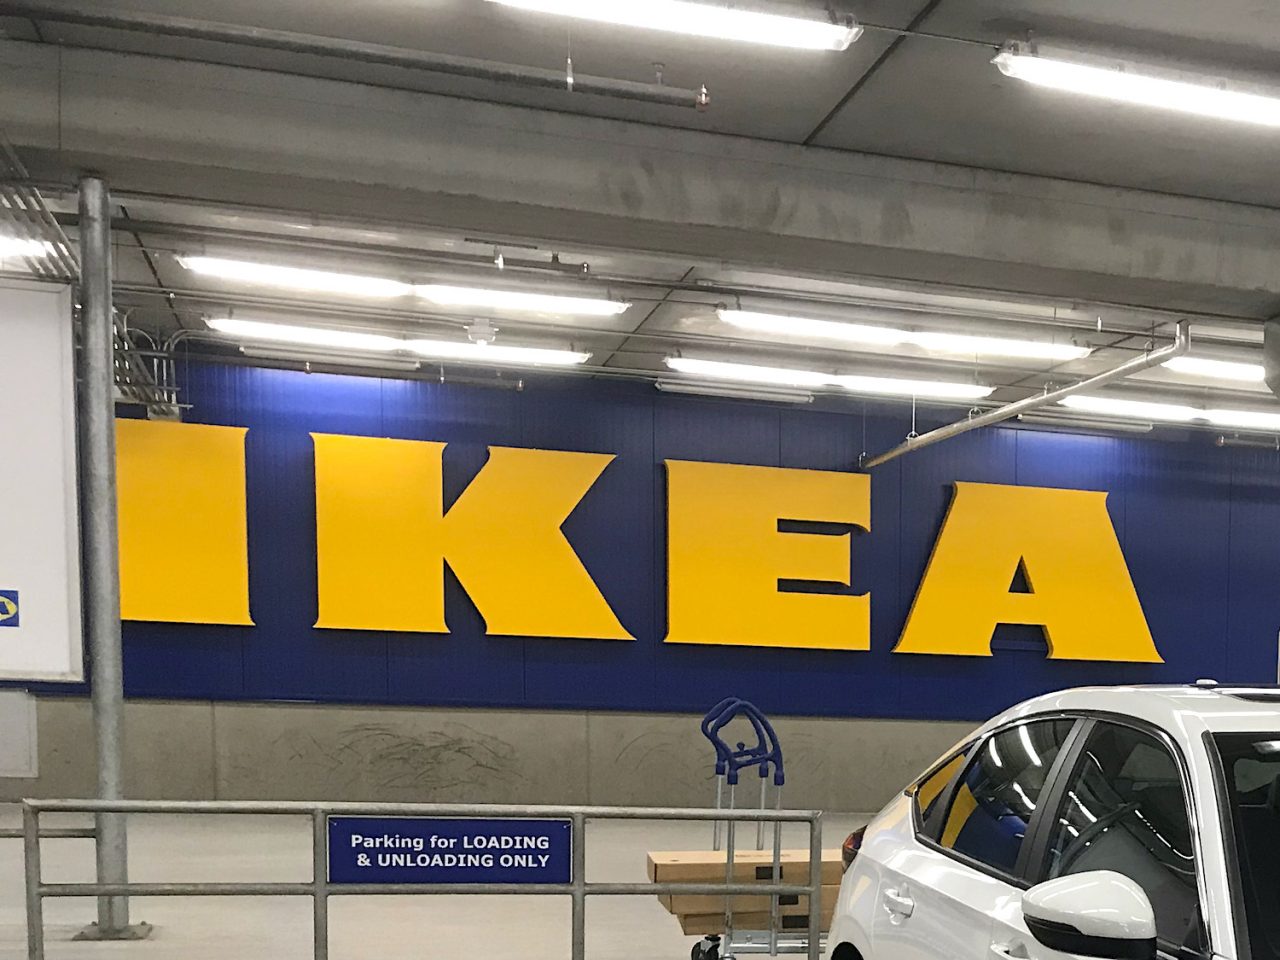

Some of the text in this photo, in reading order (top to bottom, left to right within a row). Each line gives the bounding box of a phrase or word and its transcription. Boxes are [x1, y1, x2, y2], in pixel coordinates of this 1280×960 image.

[115, 417, 1166, 663] IKEA
[351, 834, 549, 851] Parking for LOADING
[357, 853, 550, 868] & UNLOADING ONLY
